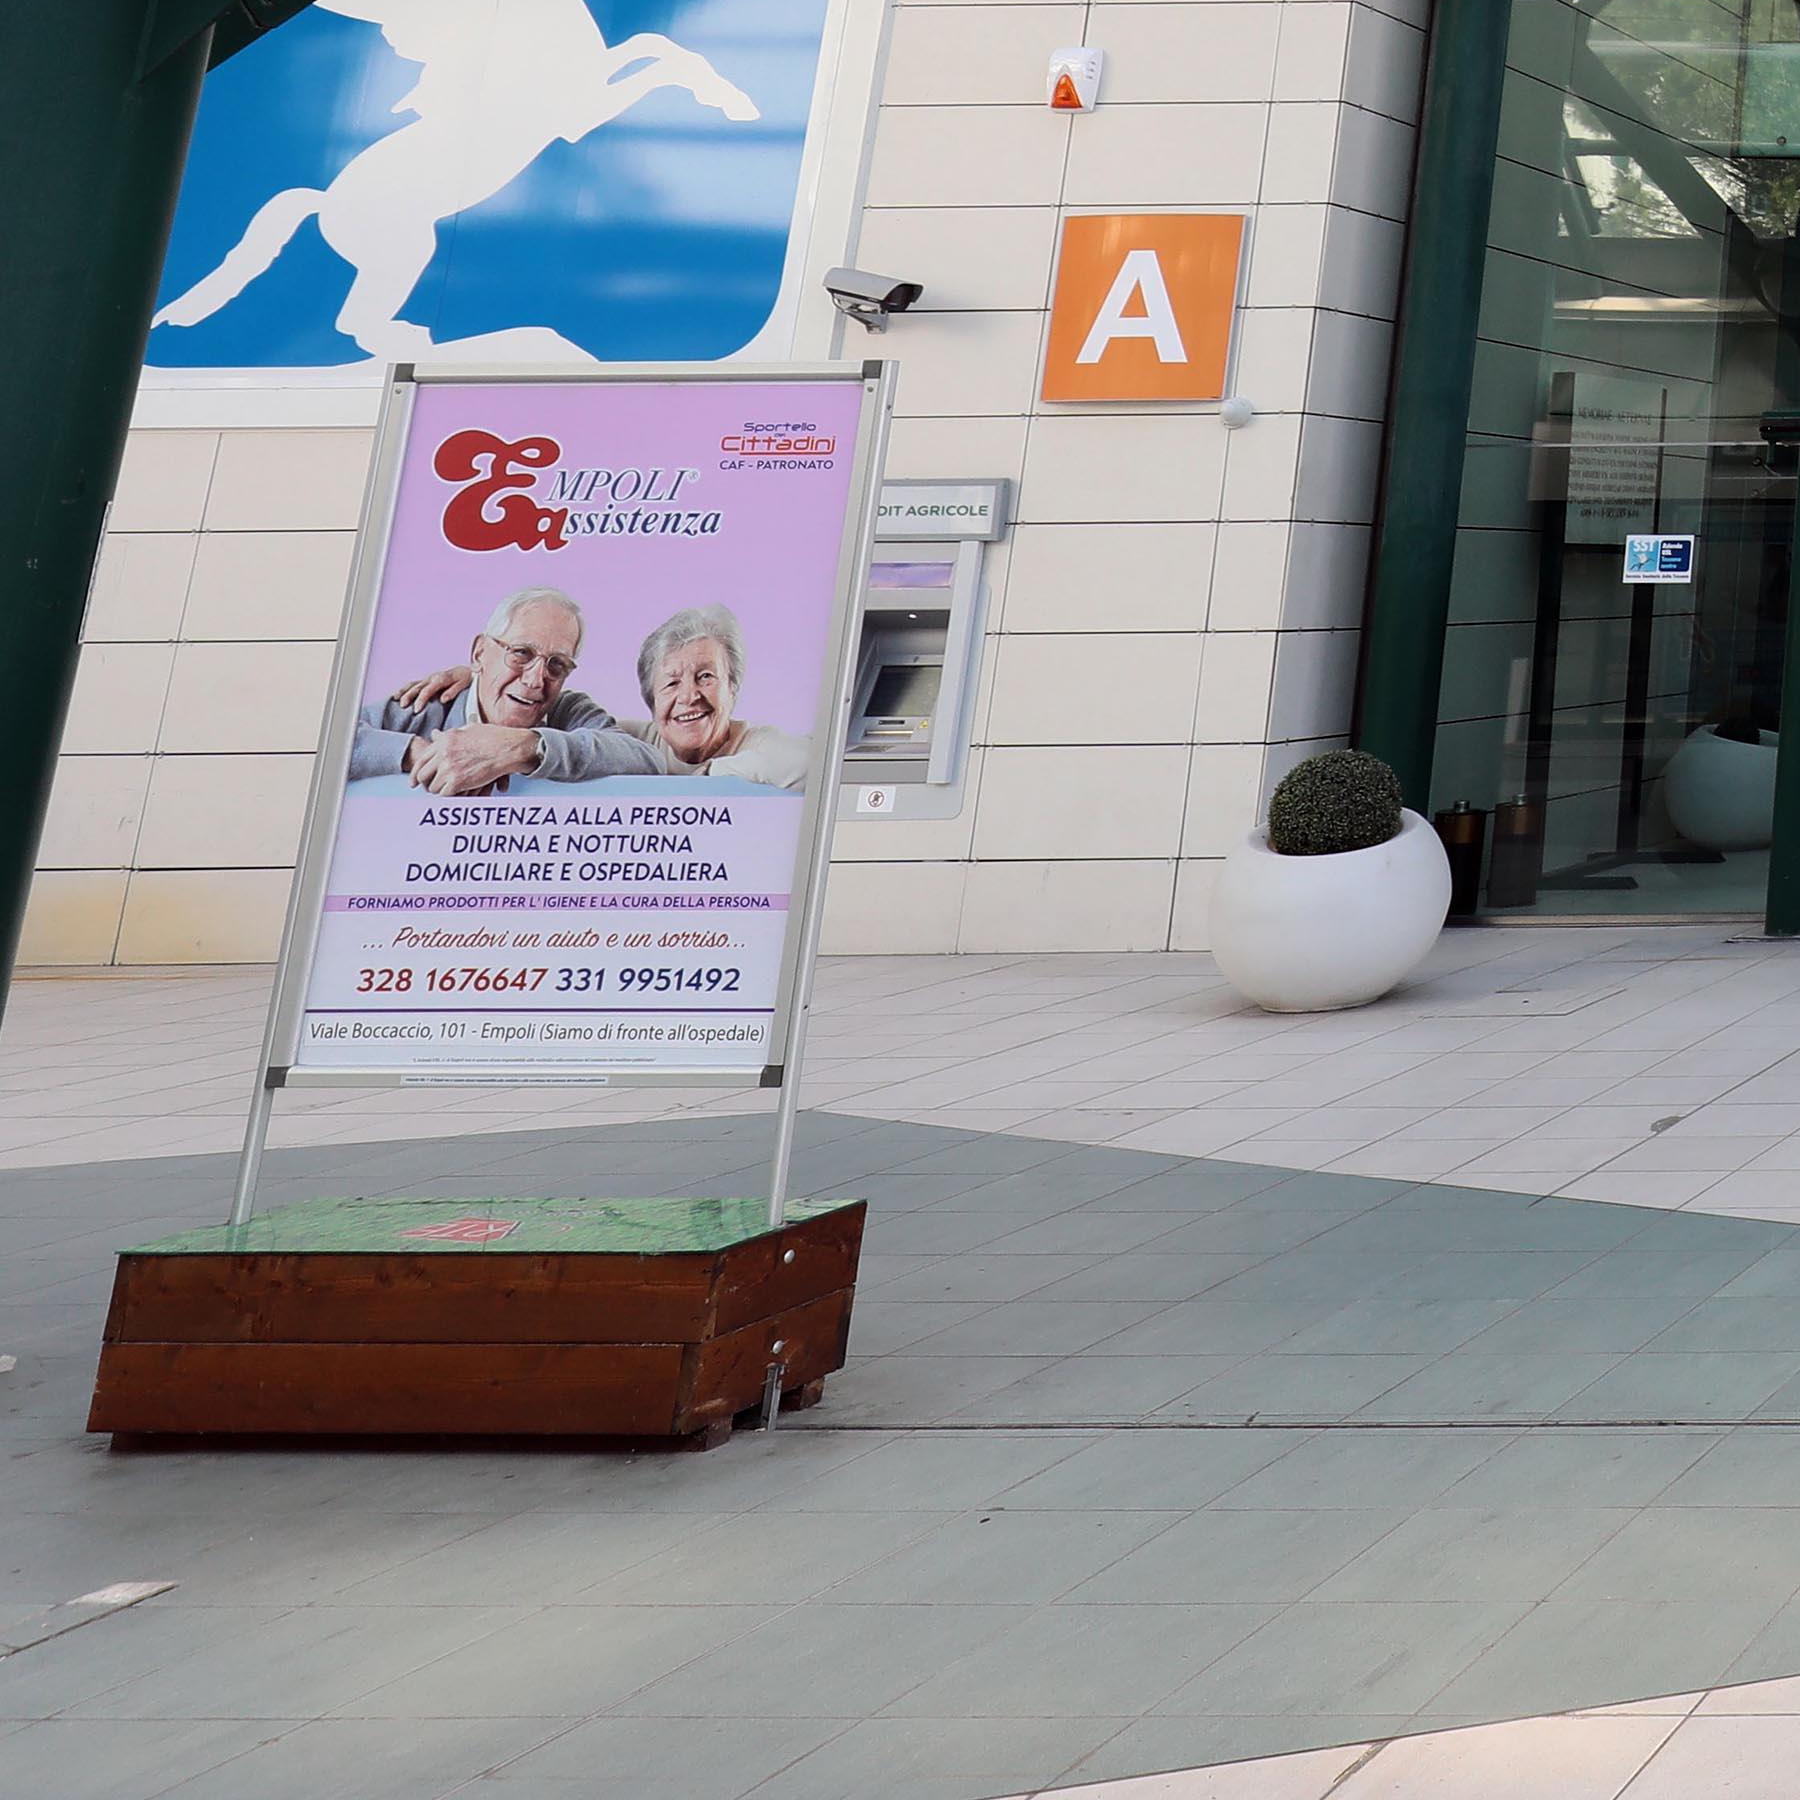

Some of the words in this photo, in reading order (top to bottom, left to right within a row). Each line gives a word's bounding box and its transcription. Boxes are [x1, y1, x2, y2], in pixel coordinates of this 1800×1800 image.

[1075, 249, 1189, 364] A
[744, 422, 817, 433] Sportello
[720, 460, 745, 470] CAF
[757, 460, 834, 470] PATRONATO
[877, 505, 904, 516] DIT
[907, 505, 989, 516] AGRICOLE
[1633, 541, 1654, 552] SST
[419, 807, 558, 826] ASSISTENZA
[563, 807, 622, 826] ALLA
[629, 807, 732, 826] PERSONA
[452, 834, 540, 853] DIURNA
[548, 834, 560, 853] E
[565, 834, 693, 853] NOTTURNA
[405, 862, 554, 882] DOMICILIARE
[559, 862, 572, 881] E
[578, 862, 728, 881] OSPEDALIERA
[348, 897, 425, 909] FORNIAMO
[428, 897, 499, 909] PRODOTTI
[501, 897, 526, 909] PER
[529, 897, 542, 908] L'
[543, 897, 587, 909] IGIENE
[588, 897, 598, 908] E
[600, 897, 619, 908] LA
[621, 897, 660, 909] CURA
[662, 897, 706, 909] DELLA
[708, 897, 771, 909] PERSONA
[393, 926, 510, 948] Portandovi
[514, 932, 541, 948] un
[548, 928, 600, 948] aiuto
[606, 934, 618, 948] e
[624, 932, 651, 948] un
[356, 968, 412, 992] 328
[425, 967, 548, 992] 1676647
[555, 968, 605, 991] 331
[617, 968, 741, 991] 9951492
[310, 1022, 349, 1040] Viale
[352, 1022, 434, 1042] Boccaccio,
[439, 1024, 466, 1039] 101
[481, 1023, 536, 1043] Empoli
[539, 1024, 594, 1044] (Siamo
[597, 1024, 613, 1040] di
[615, 1024, 665, 1041] fronte
[667, 1025, 765, 1044] all'ospedale)
